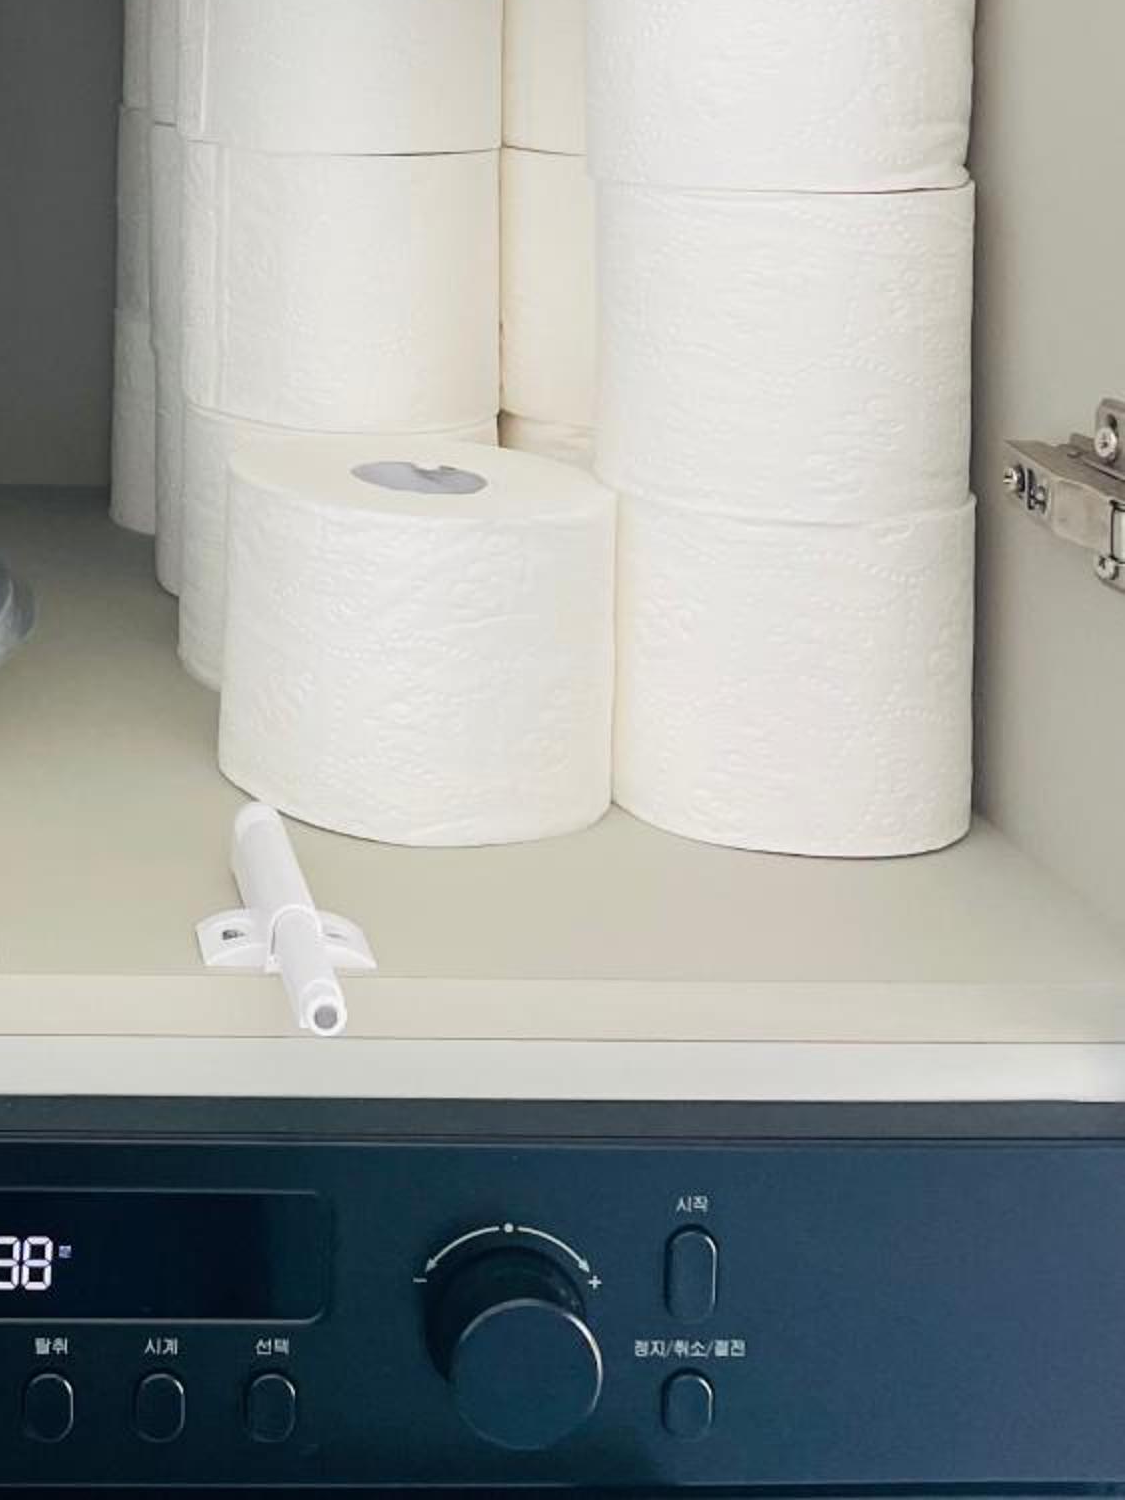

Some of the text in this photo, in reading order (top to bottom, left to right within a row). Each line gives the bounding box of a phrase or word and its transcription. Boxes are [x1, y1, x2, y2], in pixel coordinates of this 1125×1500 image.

[676, 1195, 709, 1213] 시작
[34, 1337, 69, 1356] 탈취
[143, 1338, 179, 1356] 시계
[255, 1338, 290, 1356] 선택
